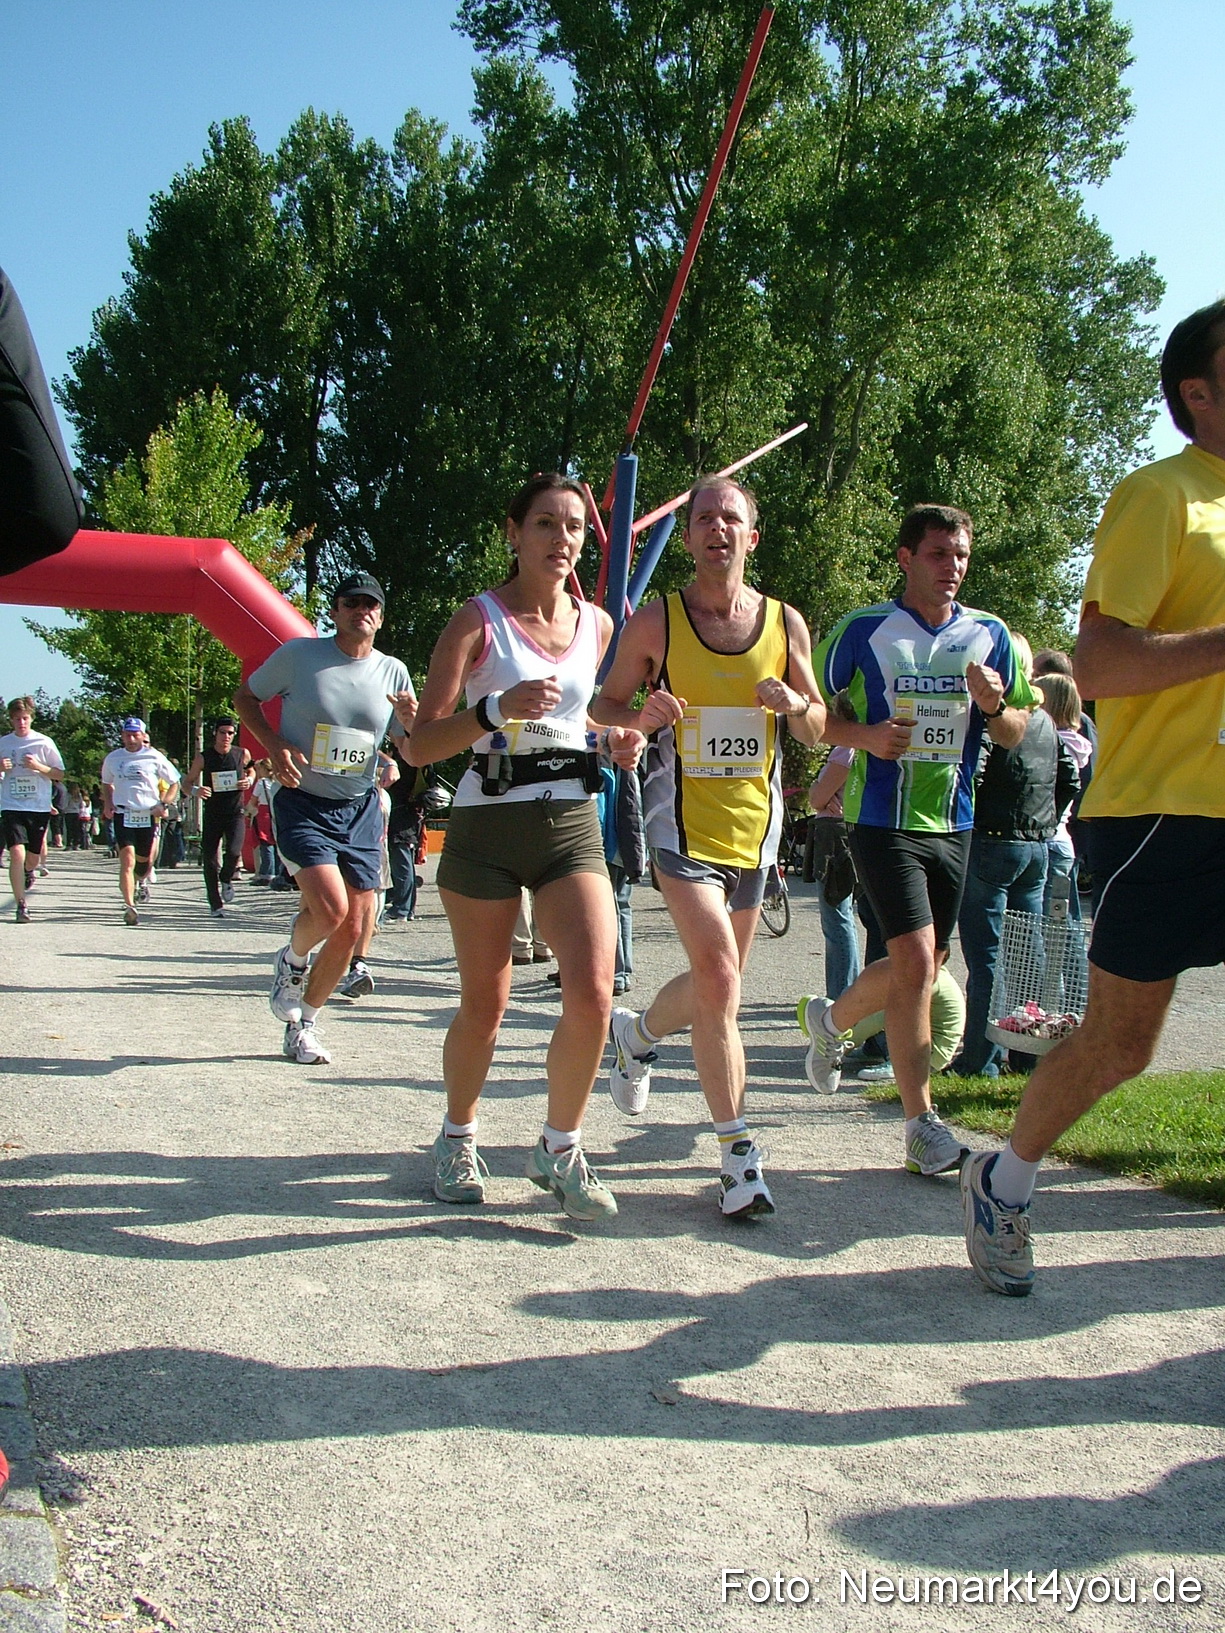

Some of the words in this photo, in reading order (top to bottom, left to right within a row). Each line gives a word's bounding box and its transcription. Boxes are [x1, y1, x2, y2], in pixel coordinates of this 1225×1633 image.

[894, 675, 968, 694] BOCK
[916, 704, 950, 718] Helmut
[524, 721, 571, 742] Susanne
[923, 727, 955, 745] 651
[331, 747, 366, 764] 1163
[707, 737, 759, 757] 1239
[18, 785, 36, 793] 3219
